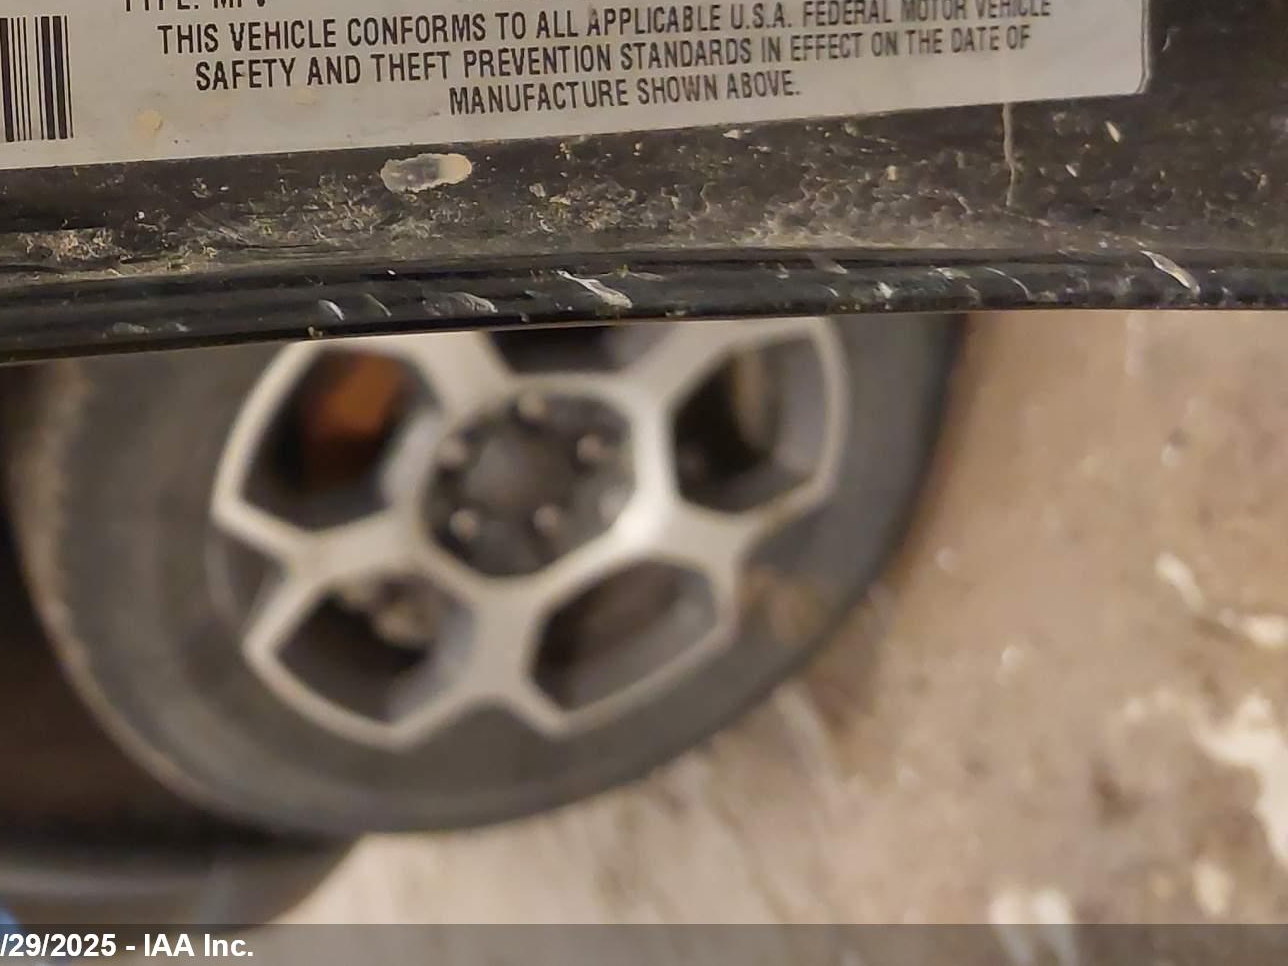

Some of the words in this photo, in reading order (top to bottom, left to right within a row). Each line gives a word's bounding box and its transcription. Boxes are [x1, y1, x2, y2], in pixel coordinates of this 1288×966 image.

[158, 23, 218, 55] THIS
[229, 18, 337, 51] VEHICLE
[347, 13, 485, 47] CONFORMS
[495, 11, 526, 40] TO
[536, 10, 580, 39] ALL
[587, 6, 722, 36] APPLICABLE
[730, 0, 793, 29] U.S.A.
[195, 59, 294, 91] SAFETY
[307, 56, 361, 86] AND
[370, 52, 450, 83] THEFT
[464, 43, 611, 78] PREVENTION
[620, 39, 751, 71] STANDARDS
[761, 37, 781, 62] IN
[791, 32, 863, 60] EFFECT
[872, 31, 898, 58] ON
[906, 29, 943, 55] THE
[951, 26, 999, 53] DATE
[1007, 24, 1032, 50] OF
[449, 80, 629, 116] MANUFACTURE
[636, 73, 718, 106] SHOWN
[727, 69, 800, 99] ABOVE.
